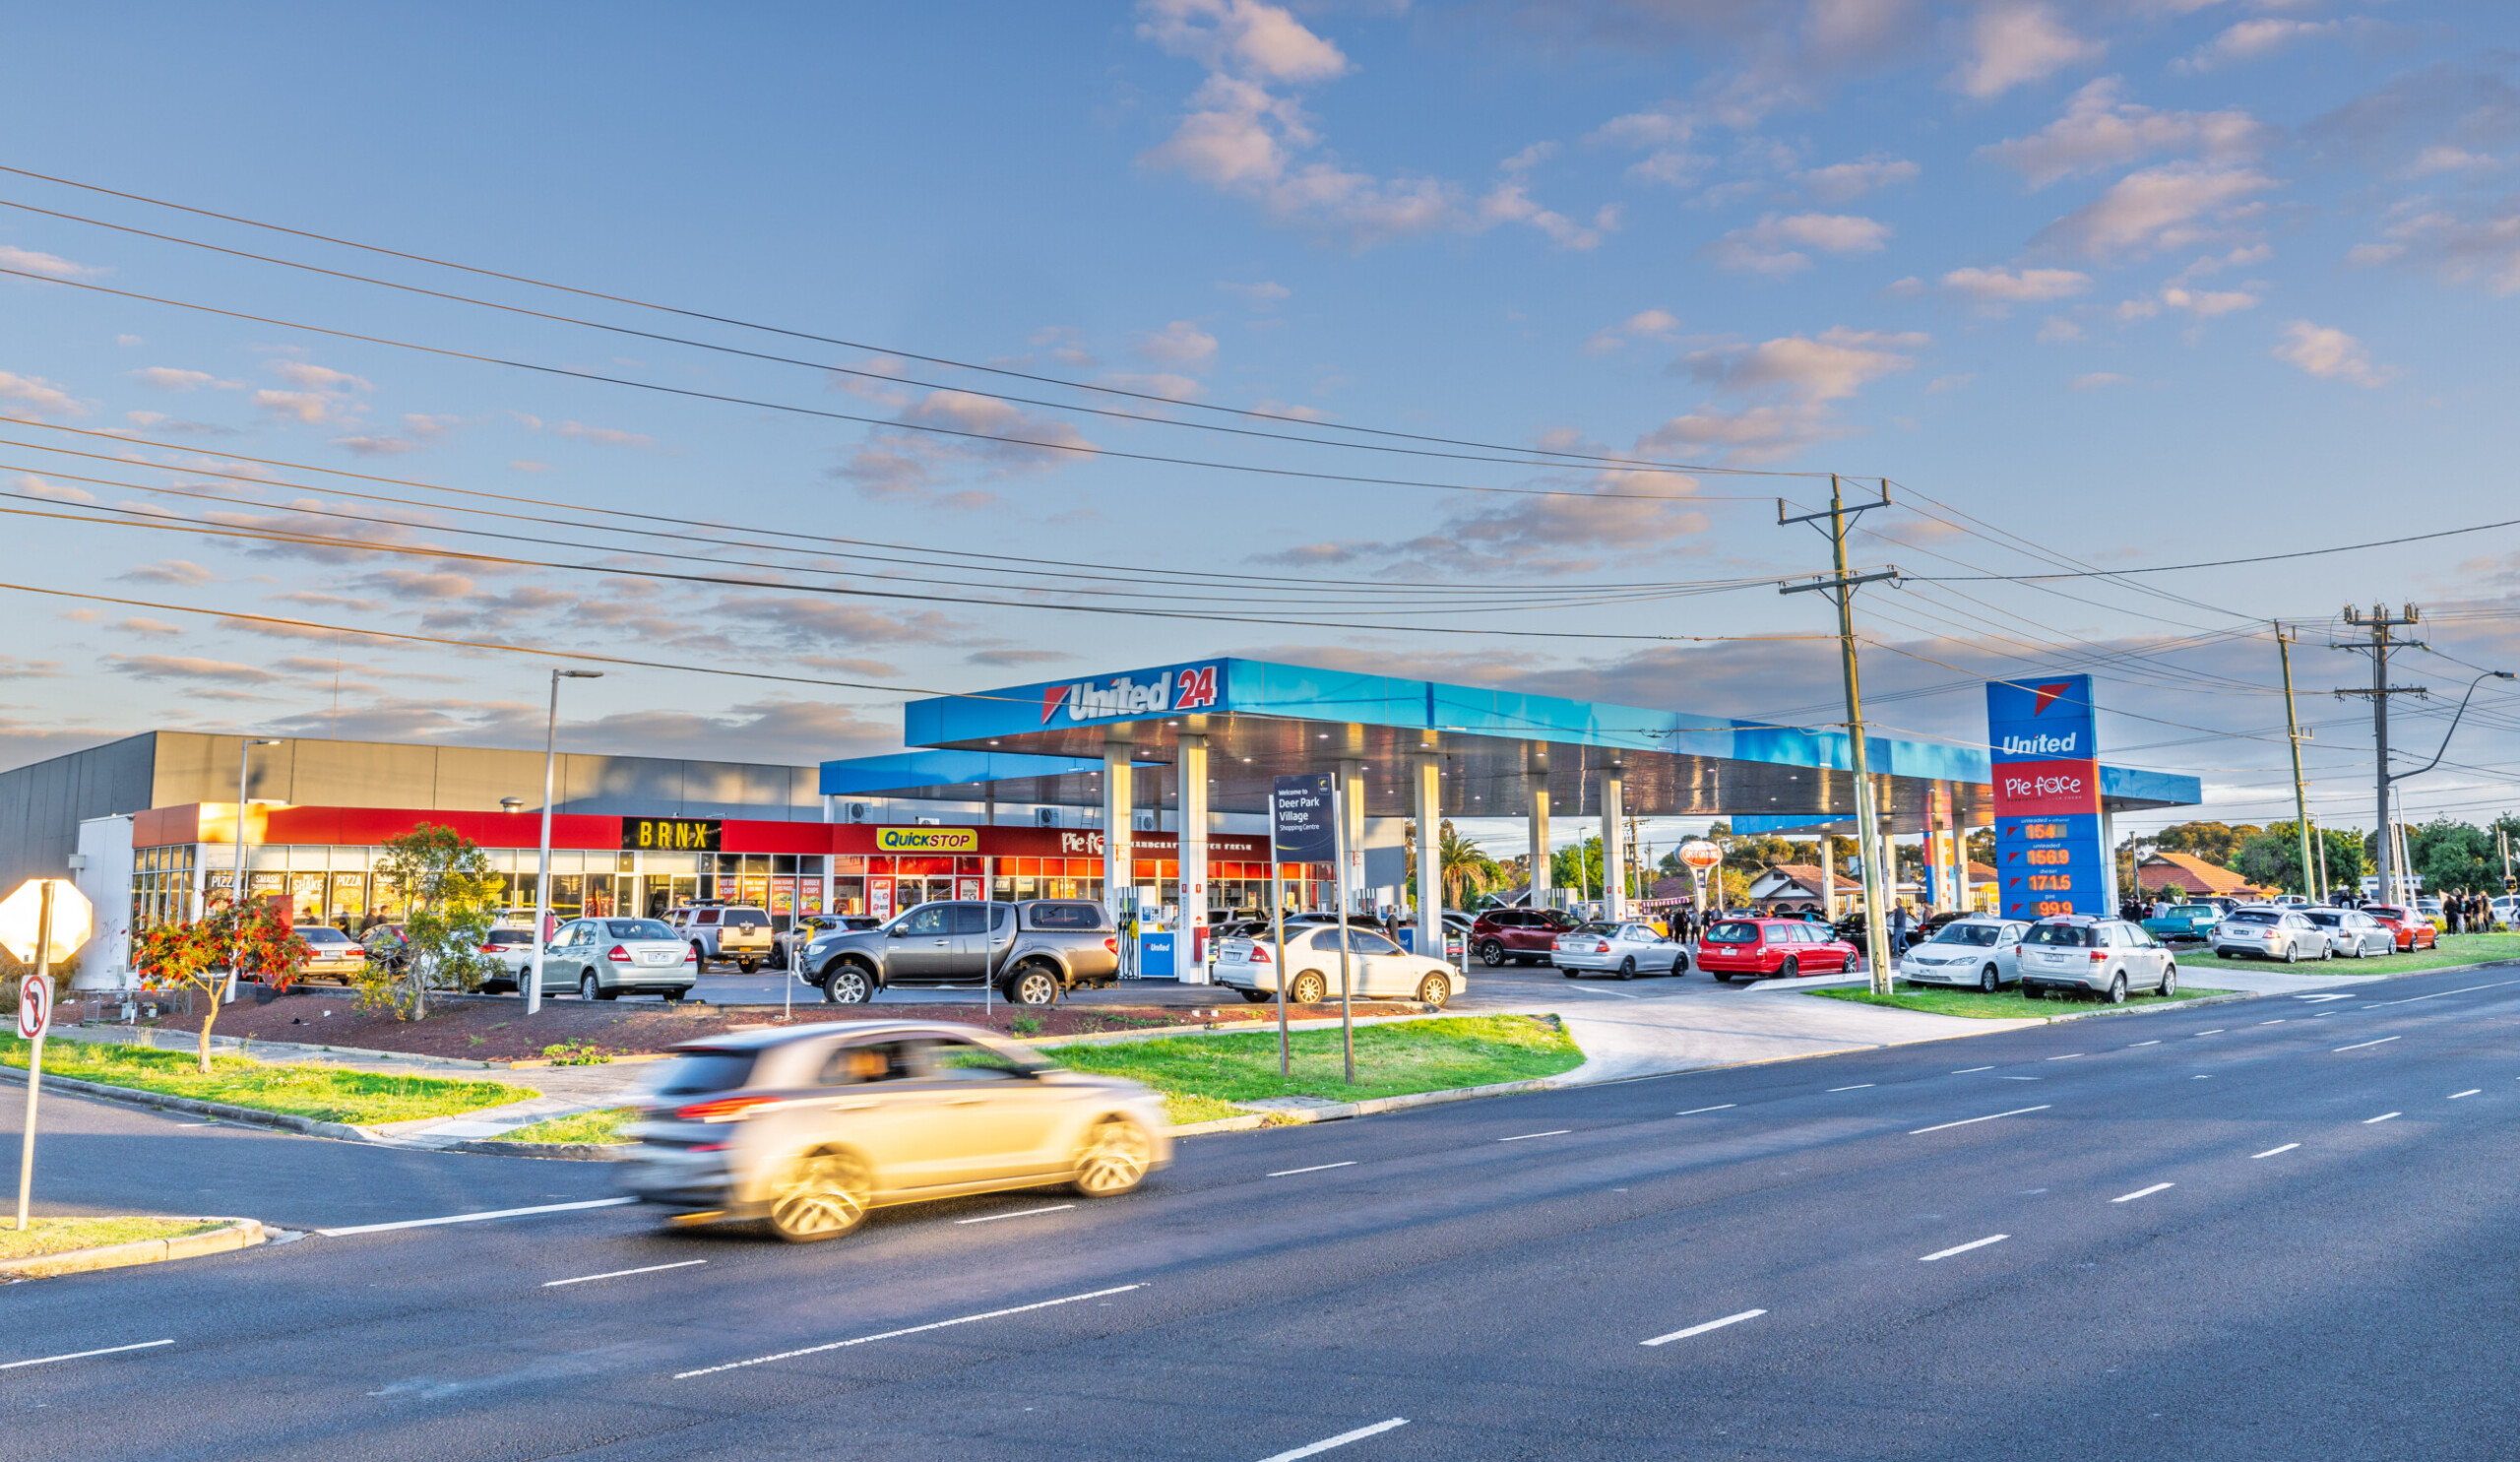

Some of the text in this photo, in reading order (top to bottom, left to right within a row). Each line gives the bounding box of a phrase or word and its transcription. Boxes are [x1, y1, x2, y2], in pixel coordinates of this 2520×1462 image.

[1068, 666, 1218, 722] United 24
[2002, 731, 2077, 755] United
[2034, 776, 2081, 796] face
[1279, 796, 1320, 808] Deer Park
[1279, 811, 1309, 823] Village
[639, 821, 707, 848] BRNX
[2027, 849, 2070, 864] 156.9
[211, 875, 234, 888] PIZZ
[255, 874, 281, 884] SMASH
[292, 879, 324, 891] SHAKE
[336, 874, 362, 887] PIZZA
[2029, 874, 2071, 890] 171.5
[2039, 901, 2073, 917] 999
